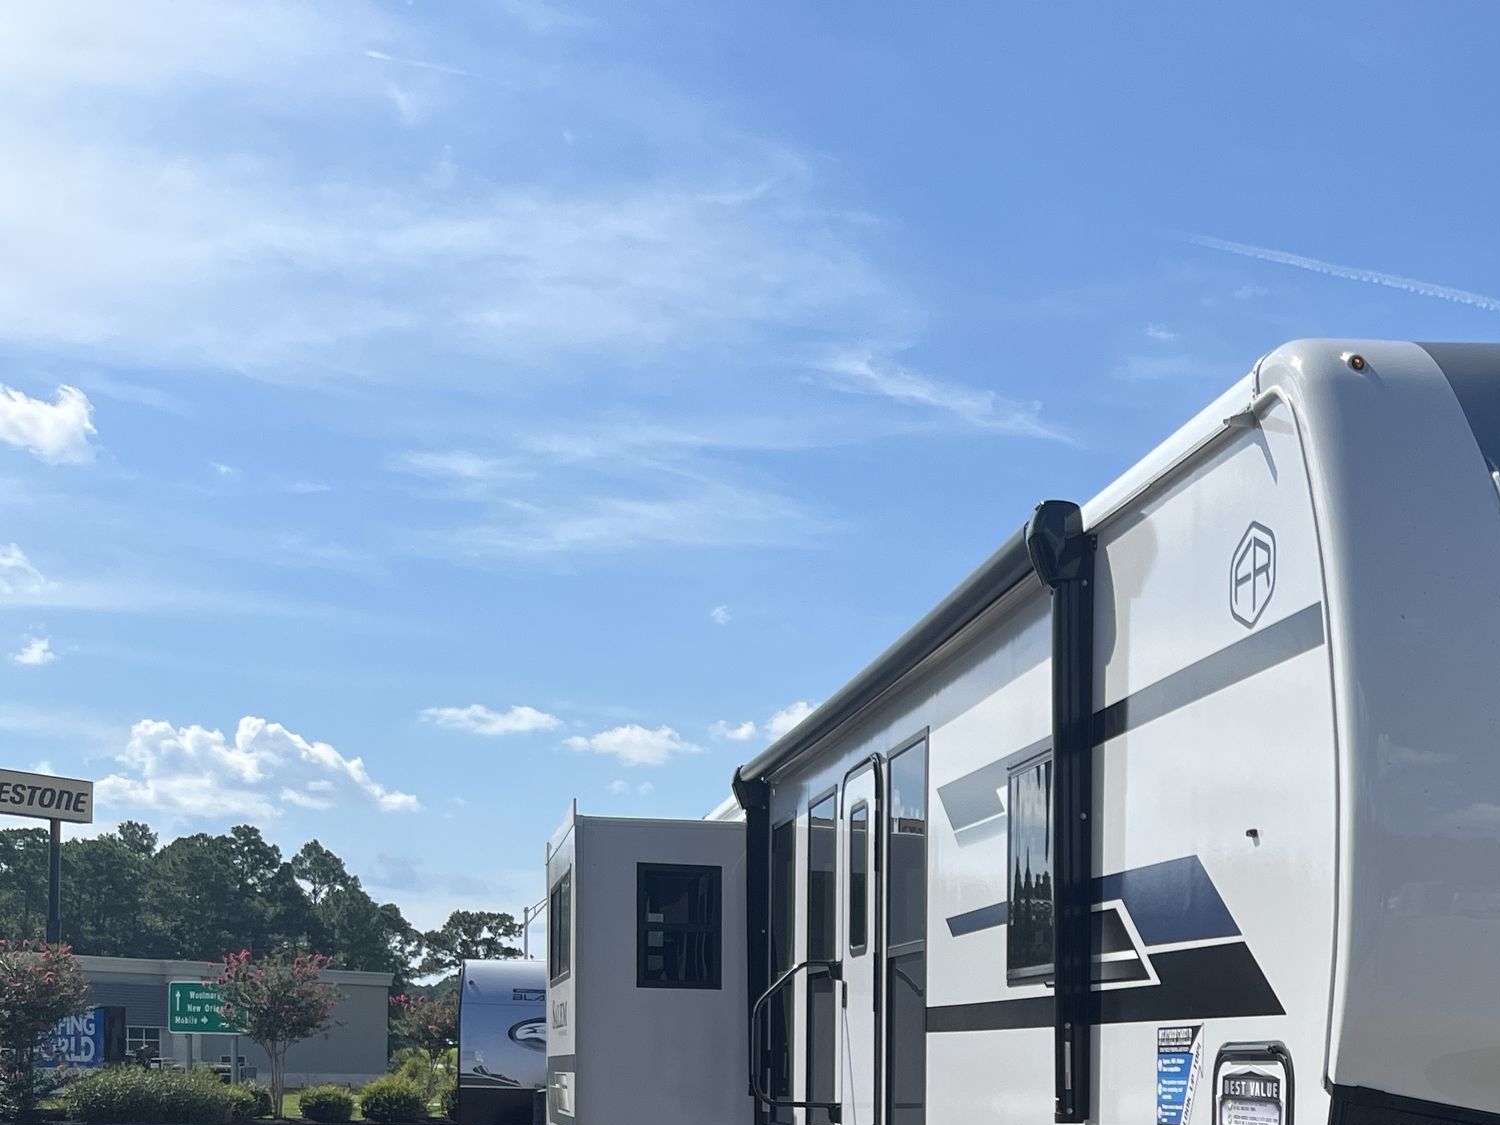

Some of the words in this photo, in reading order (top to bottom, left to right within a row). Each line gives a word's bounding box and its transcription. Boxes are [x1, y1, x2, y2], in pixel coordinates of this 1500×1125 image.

[187, 1004, 201, 1012] New
[175, 1016, 198, 1025] Mobile
[1224, 1079, 1247, 1096] BEST
[1249, 1081, 1279, 1098] VALUE
